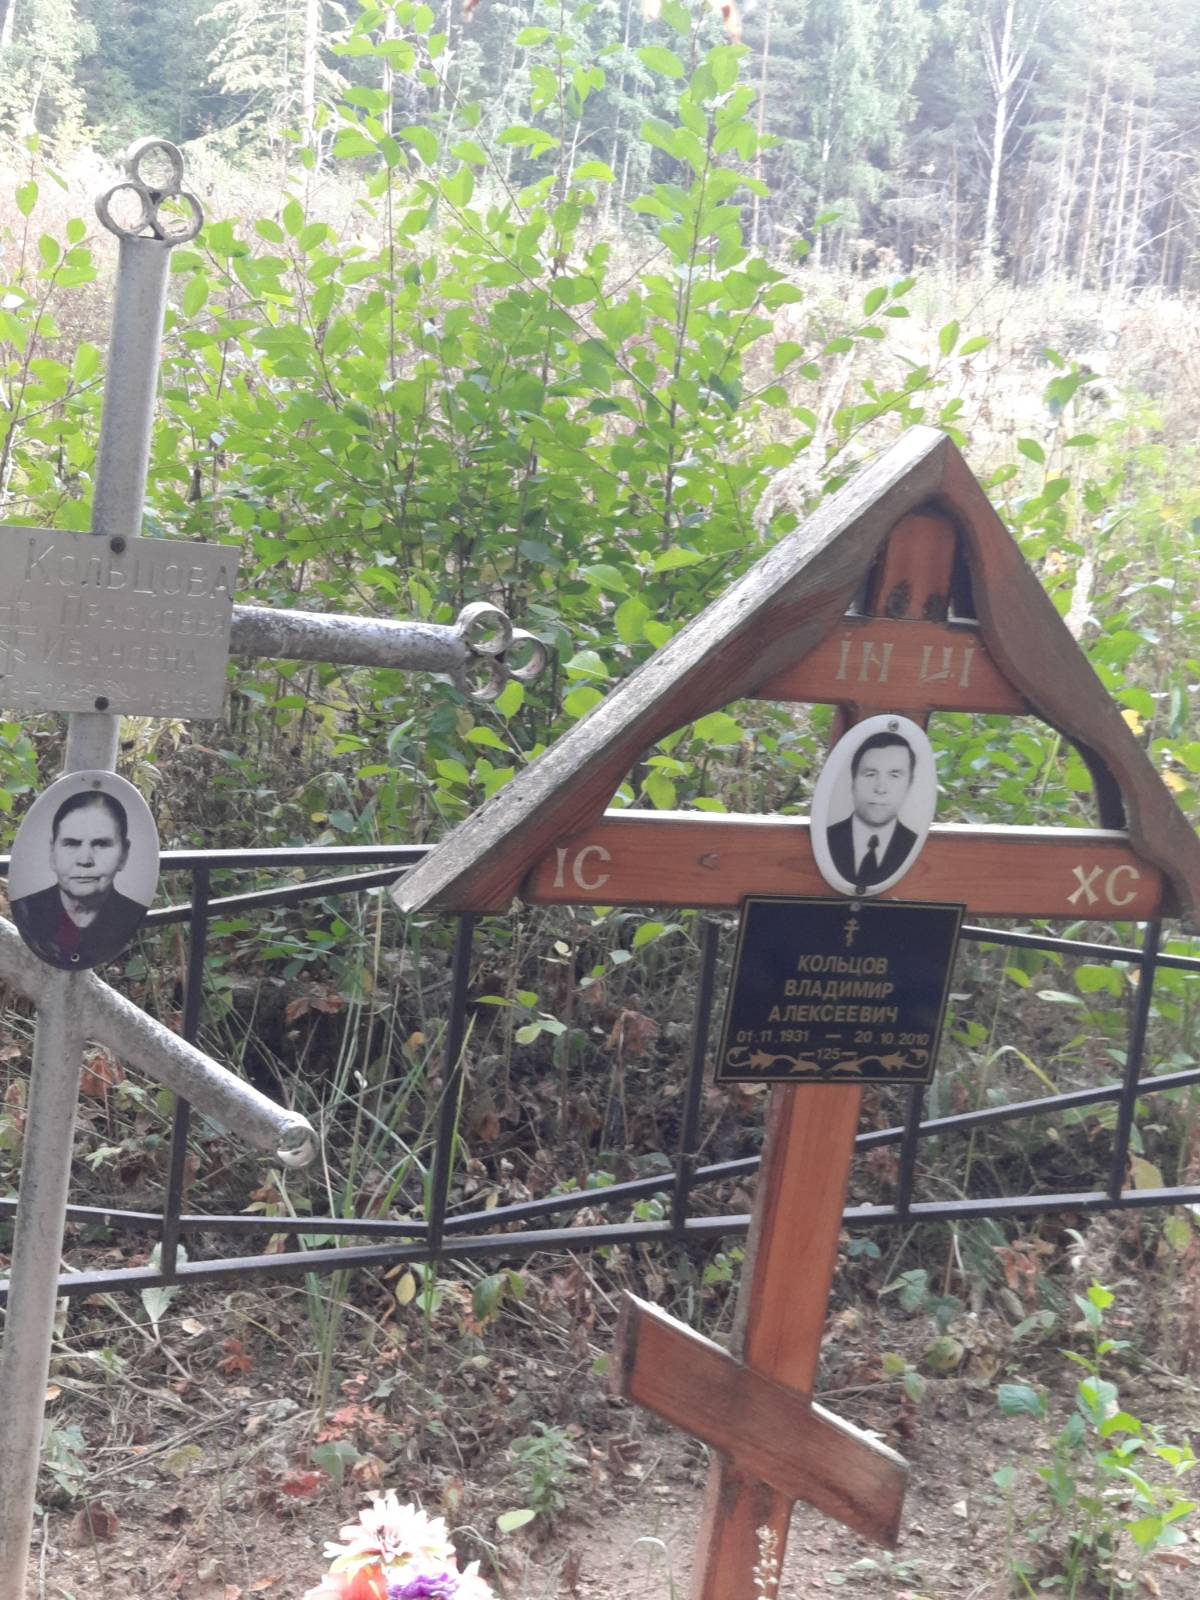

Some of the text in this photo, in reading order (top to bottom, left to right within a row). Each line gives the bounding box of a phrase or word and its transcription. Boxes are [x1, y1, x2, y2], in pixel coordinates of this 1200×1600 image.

[25, 539, 231, 599] КОЛЬЦОВА
[797, 954, 889, 976] КОЛЬЦОВ
[784, 979, 895, 1001] ВЛАДИМИР
[768, 1005, 899, 1024] АЛЕКСЕЕВИЧ
